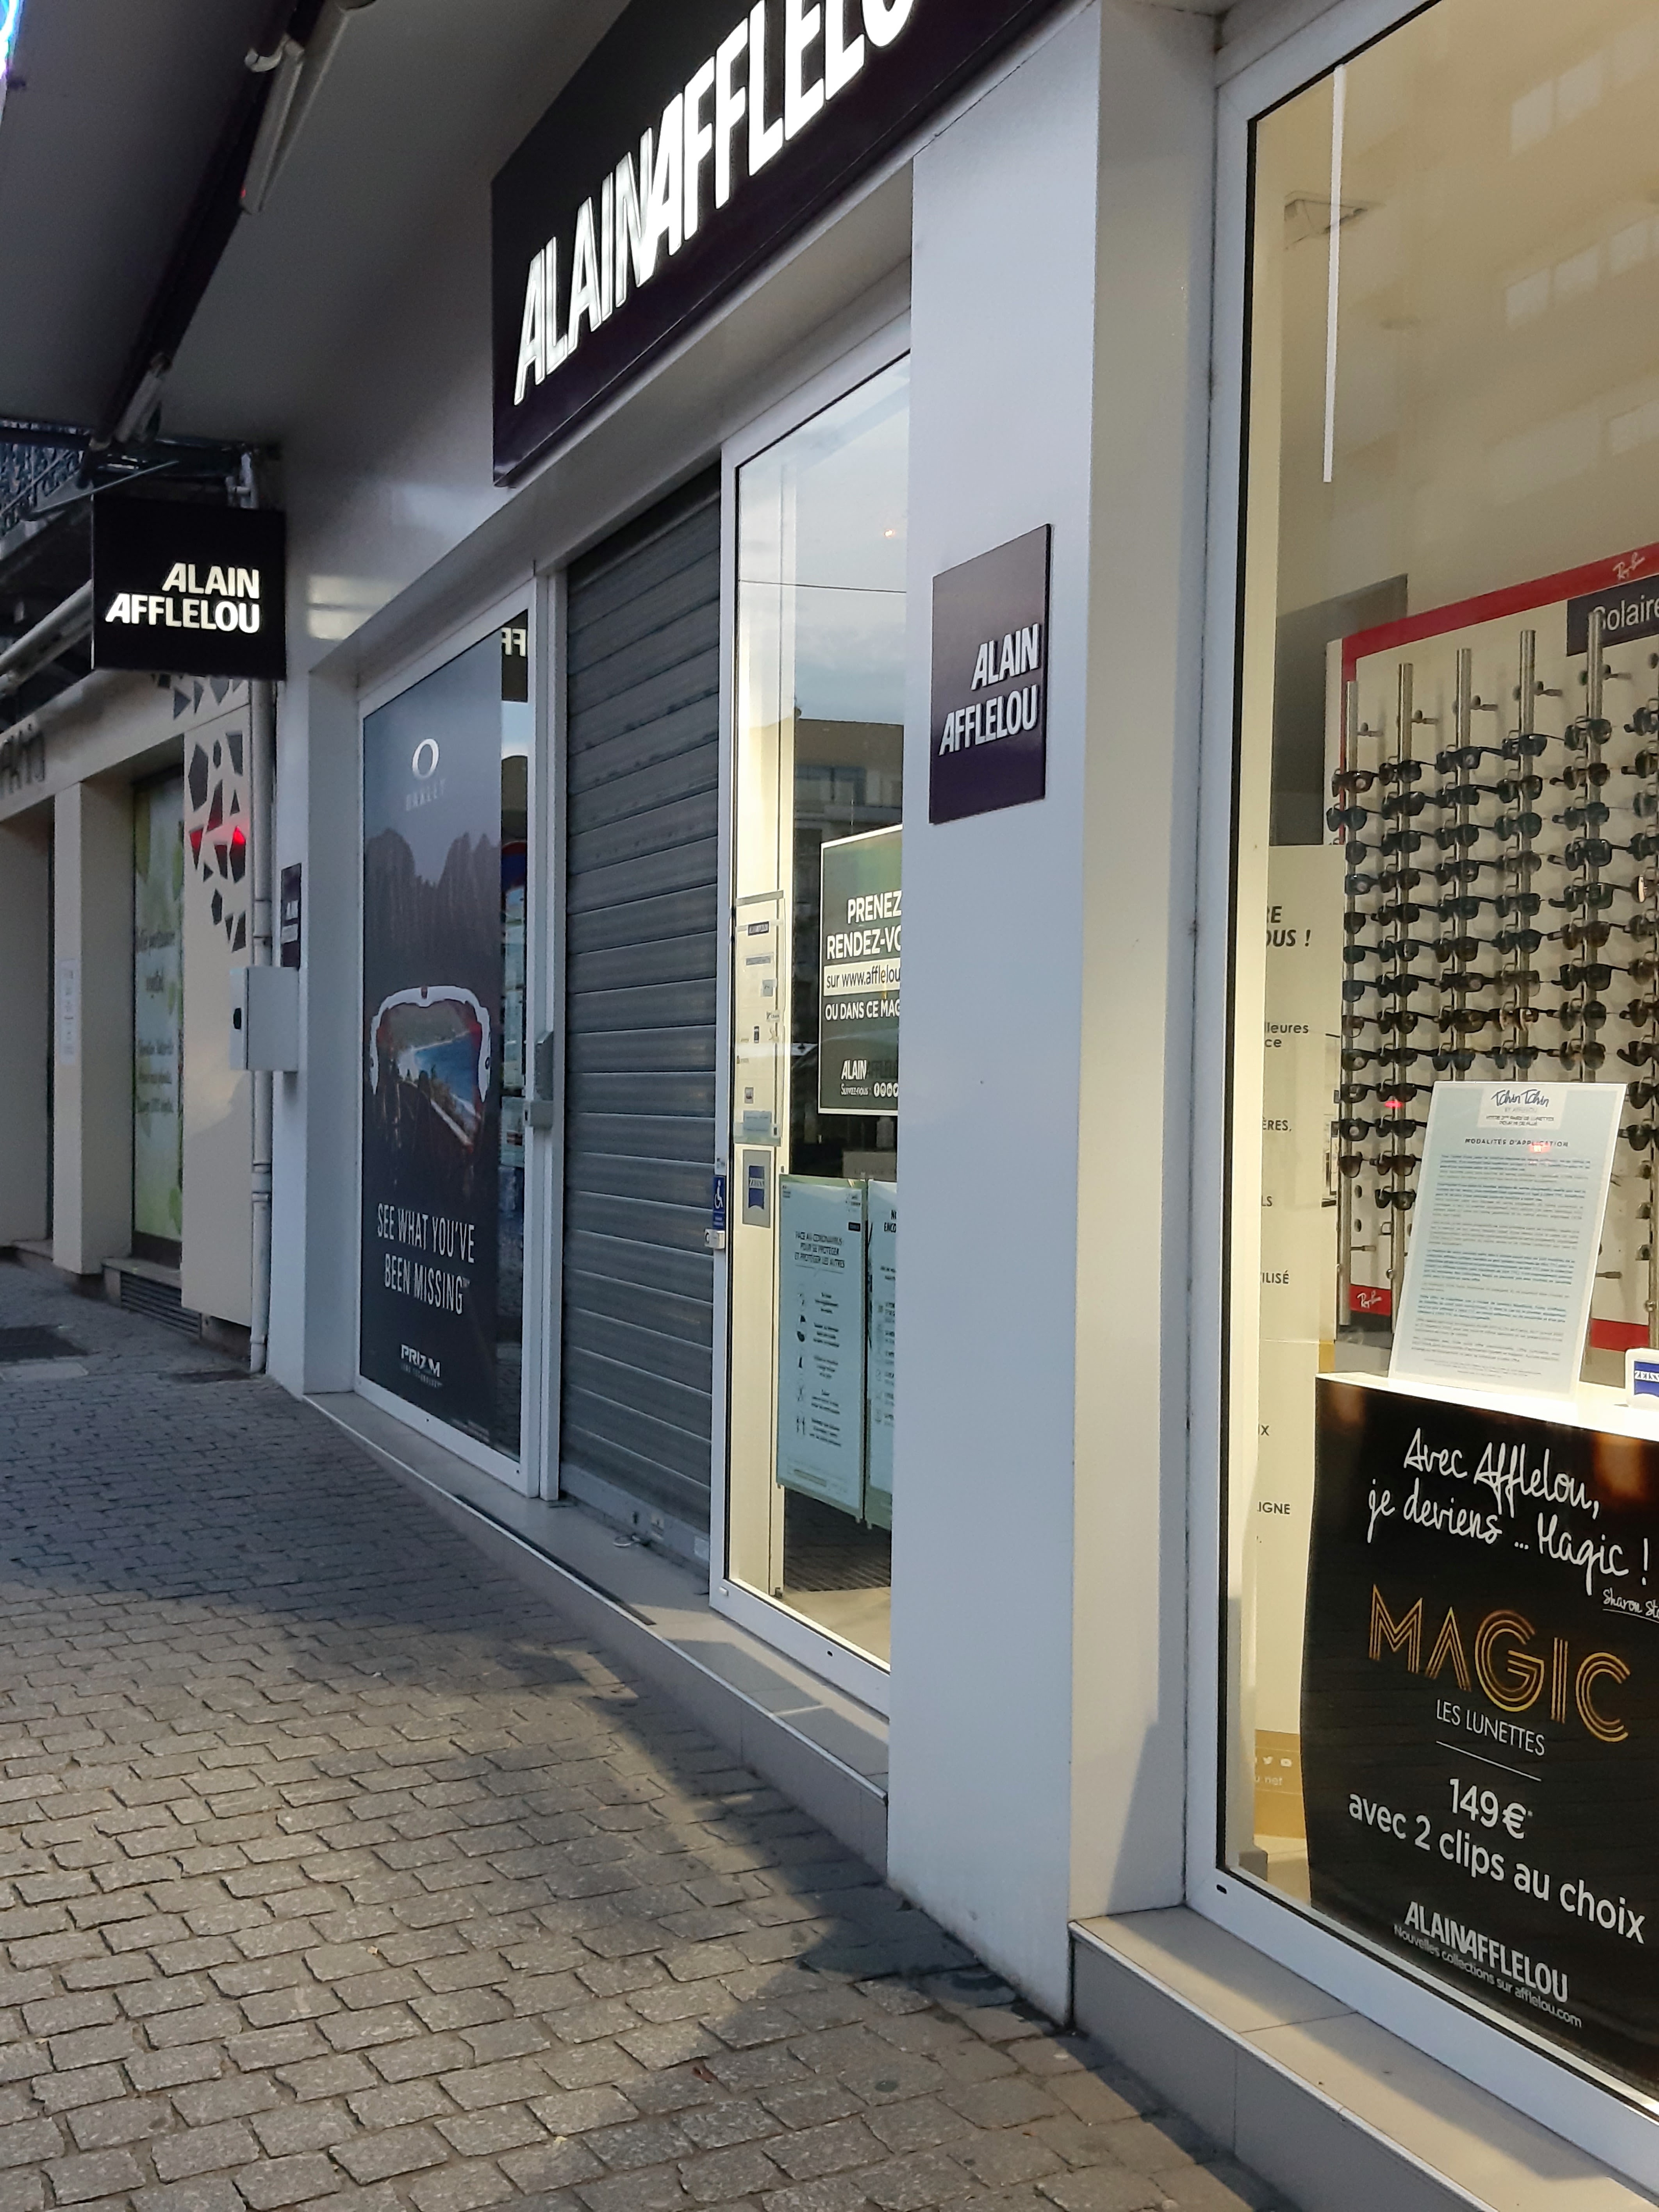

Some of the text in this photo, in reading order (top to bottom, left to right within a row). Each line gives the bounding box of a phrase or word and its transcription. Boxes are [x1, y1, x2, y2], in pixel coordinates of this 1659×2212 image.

[514, 0, 915, 405] ALAINAFFLEL
[162, 562, 259, 599] ALAIN
[106, 593, 259, 633] AFFLELOU
[971, 624, 1040, 690] ALAIN
[939, 685, 1038, 755] AFFLELOU
[847, 890, 902, 924] PRENEZ
[1267, 906, 1282, 923] E
[826, 974, 840, 988] sur
[825, 1004, 838, 1021] OU
[840, 1002, 864, 1020] DANS
[865, 1001, 879, 1018] CE
[841, 1060, 867, 1080] ALAIN
[377, 1203, 475, 1263] SEE WHAT YOU'VE
[385, 1254, 410, 1295] BEEN
[1261, 1270, 1290, 1284] ILISÉ
[1404, 1428, 1599, 1519] Avec Afflelou,
[1257, 1502, 1290, 1515] IGNE
[1367, 1479, 1395, 1543] je
[1404, 1478, 1502, 1544] deviens
[1537, 1513, 1629, 1596] Magic
[1603, 1587, 1643, 1613] Sharon
[1368, 1583, 1631, 1742] MAGIC
[1436, 1699, 1546, 1756] LES LUNETTES
[1349, 1793, 1645, 1944] avec 2 clips au choix
[1393, 1924, 1582, 2028] Nouvelles collections sur afflelou.com
